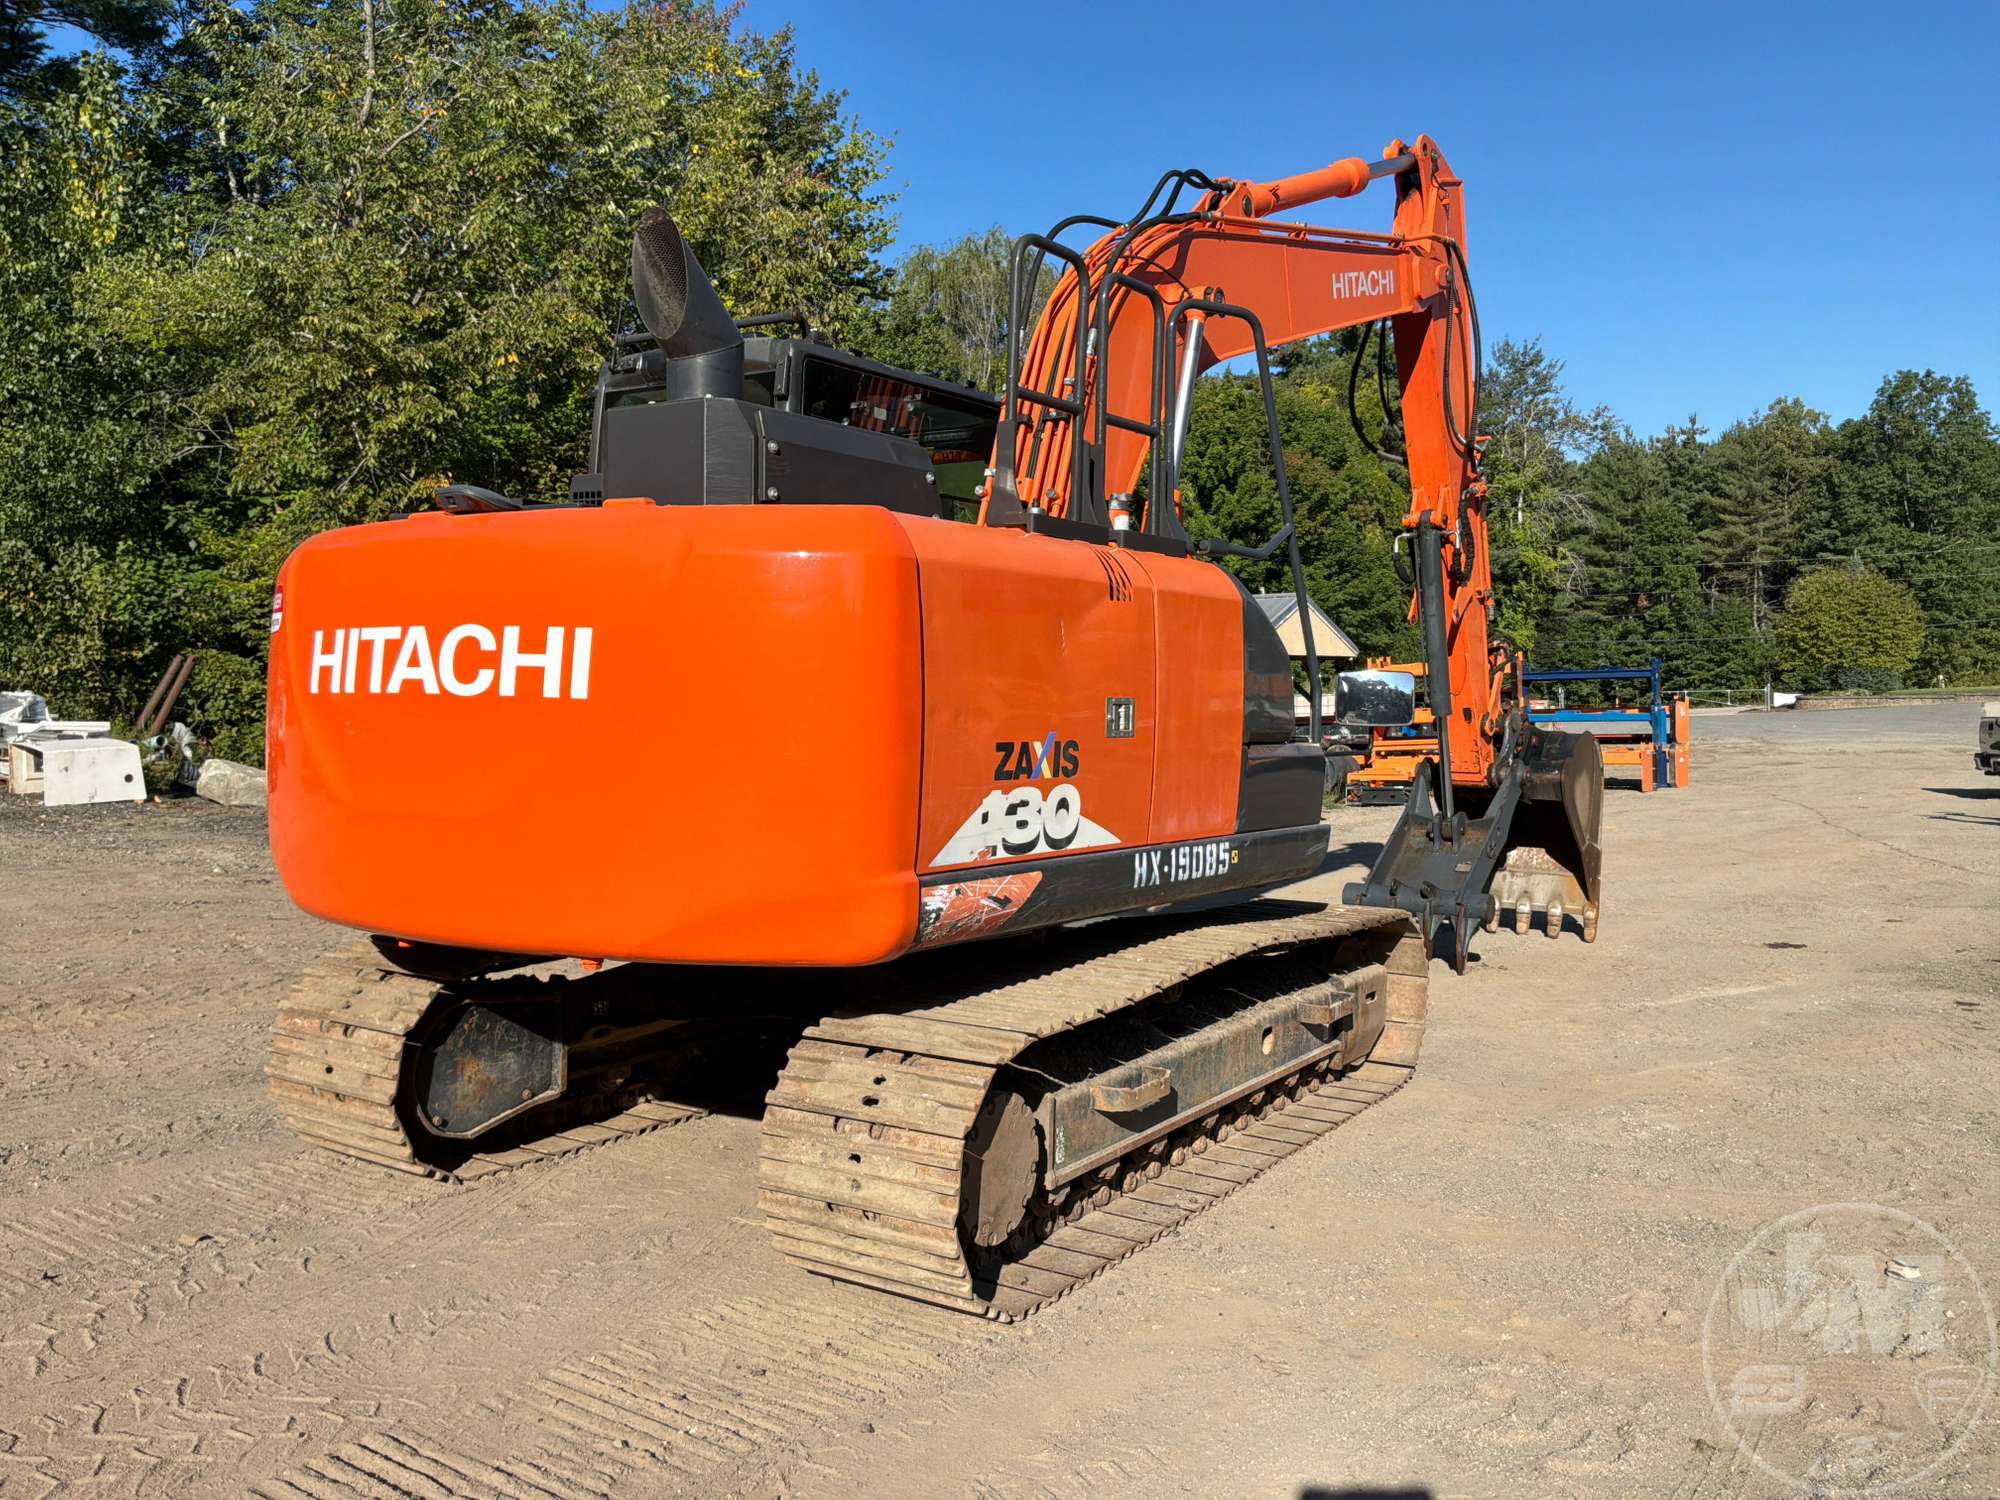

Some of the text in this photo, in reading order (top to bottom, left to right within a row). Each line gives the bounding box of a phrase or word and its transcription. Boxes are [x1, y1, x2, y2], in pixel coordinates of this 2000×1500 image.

[1331, 269, 1395, 300] HITACHI
[309, 623, 593, 700] HITACHI
[994, 731, 1080, 781] ZAXIS
